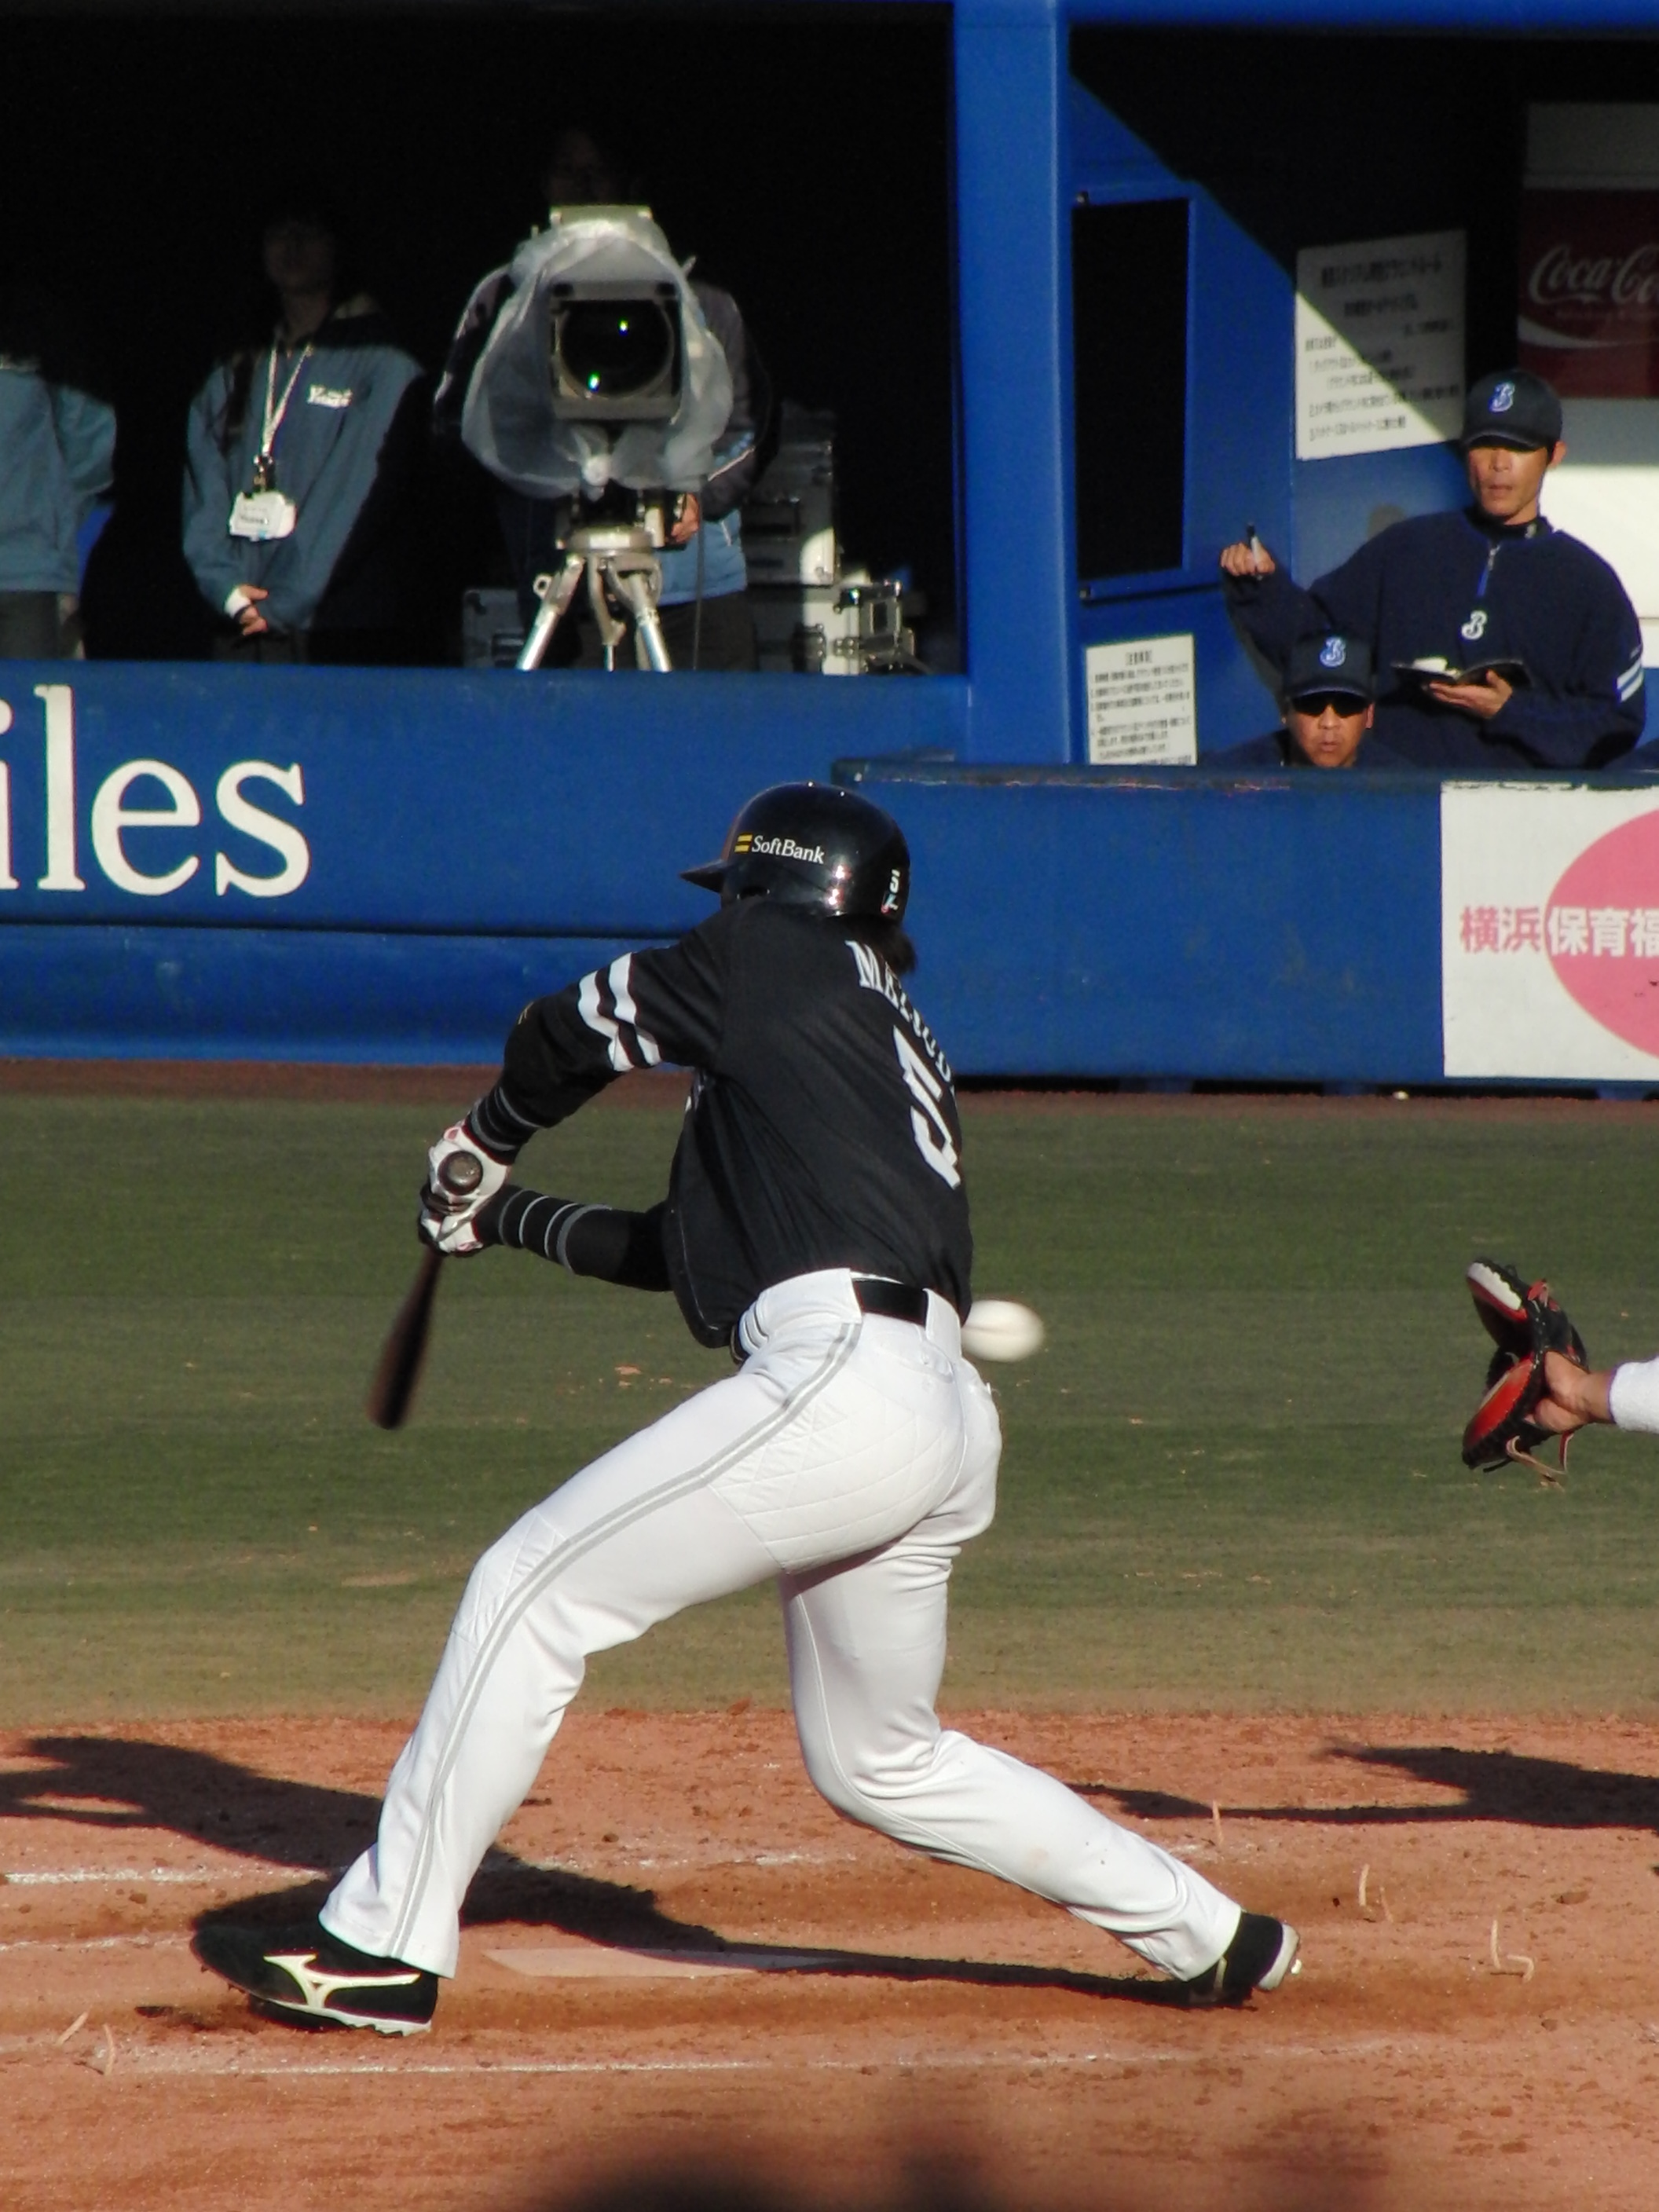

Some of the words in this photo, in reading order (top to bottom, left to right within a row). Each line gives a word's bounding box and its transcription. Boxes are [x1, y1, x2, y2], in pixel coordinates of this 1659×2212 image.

[1489, 382, 1515, 412] B
[1461, 610, 1487, 640] B
[1320, 636, 1346, 668] B
[752, 834, 825, 865] SoftBank
[1459, 905, 1659, 958] 横浜保育福
[893, 1024, 961, 1190] 5
